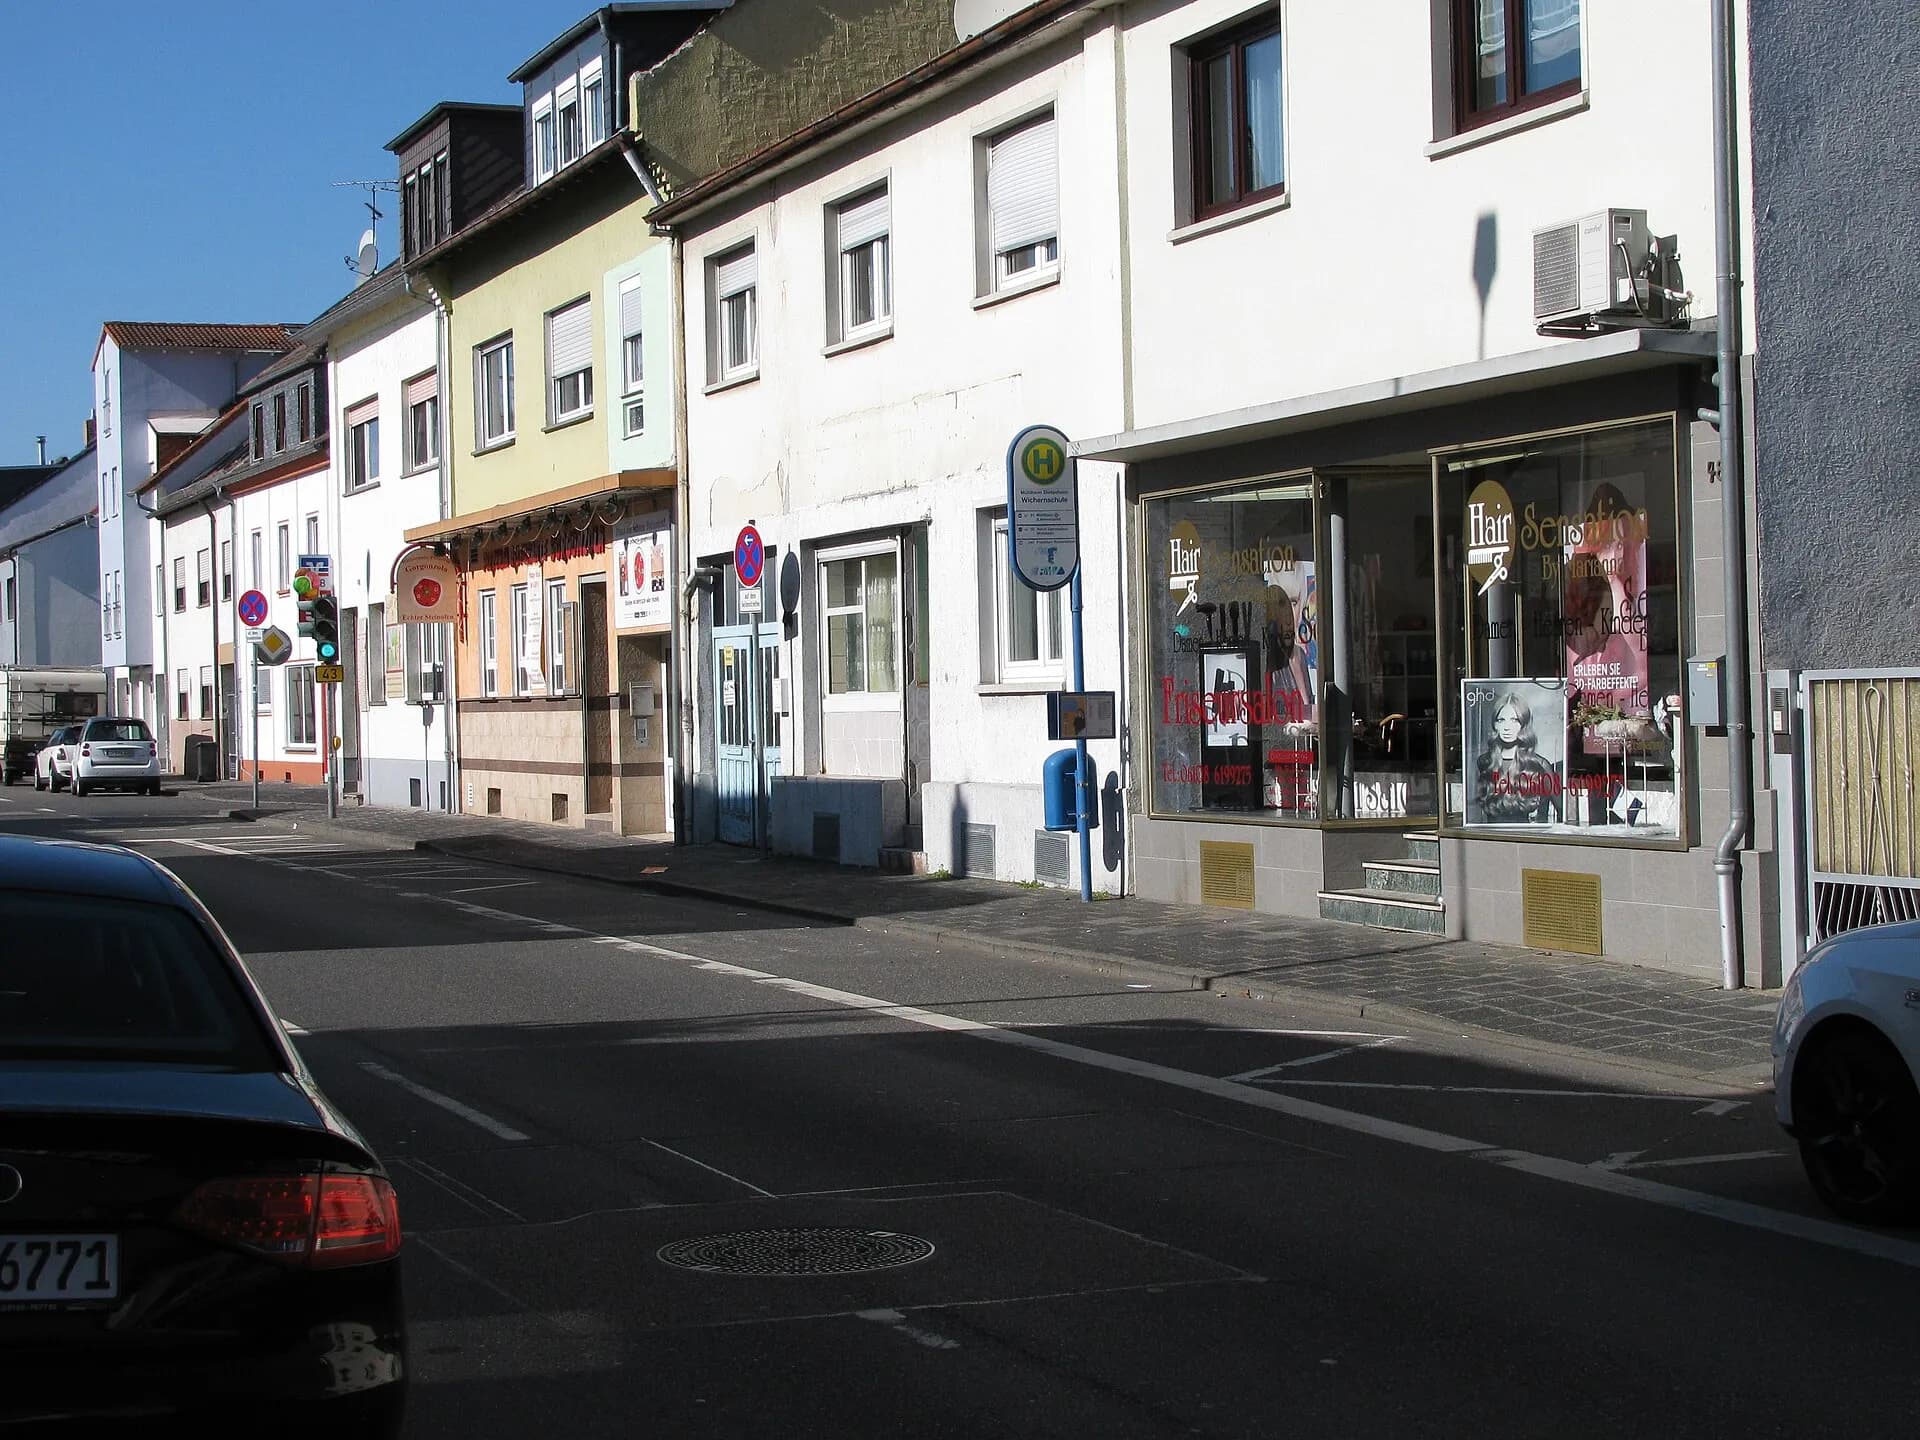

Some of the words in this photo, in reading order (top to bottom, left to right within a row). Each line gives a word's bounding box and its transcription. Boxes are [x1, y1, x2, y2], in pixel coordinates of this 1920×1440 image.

[1032, 448, 1054, 475] H
[1468, 502, 1512, 547] Hair
[1520, 498, 1647, 550] Sensation
[1169, 538, 1201, 575] Hair
[1210, 536, 1296, 577] nsation
[322, 668, 338, 680] 43
[1573, 663, 1608, 677] ERLEBEN
[1609, 662, 1621, 676] SIE
[1161, 671, 1304, 727] Friseursalon
[1466, 687, 1496, 708] ghd
[0, 1240, 111, 1292] 6771
